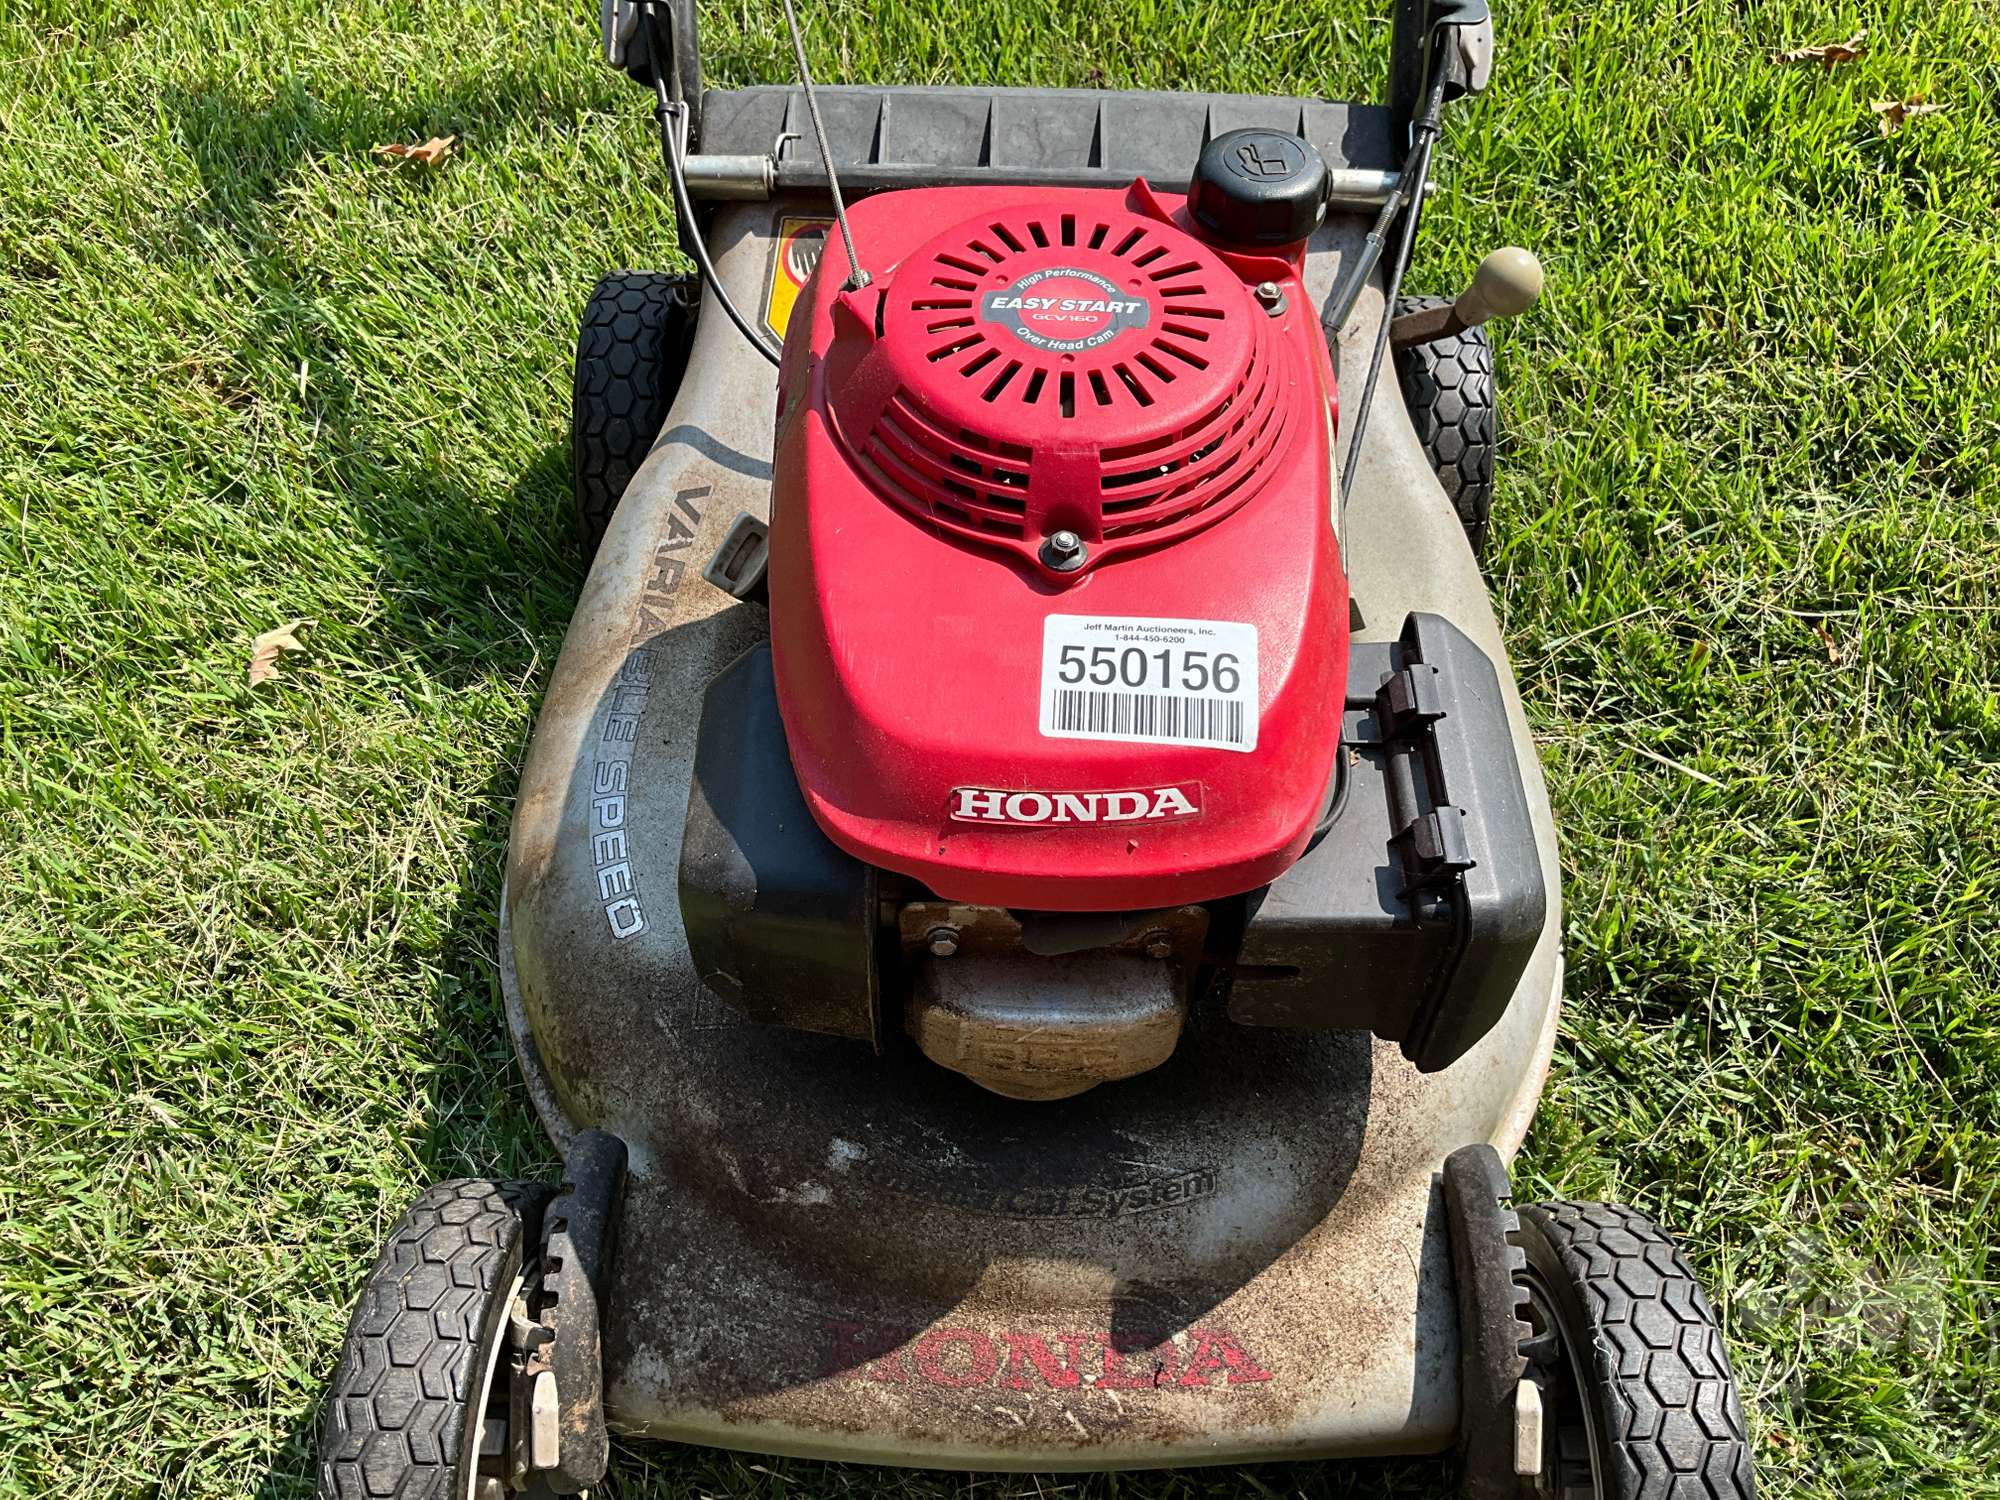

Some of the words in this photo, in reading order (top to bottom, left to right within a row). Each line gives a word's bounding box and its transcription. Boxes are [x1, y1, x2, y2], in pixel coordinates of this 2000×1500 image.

[1017, 272, 1043, 290] High
[1045, 268, 1116, 293] Performance
[991, 297, 1056, 310] EASY
[1060, 299, 1141, 313] START
[1016, 327, 1045, 345] Over
[1048, 340, 1083, 350] Head
[1087, 330, 1114, 346] Cam
[1084, 623, 1102, 631] Jeff
[1104, 624, 1134, 632] Martin
[1136, 625, 1197, 636] Auctioneers,
[1199, 628, 1216, 636] Inc.
[1115, 635, 1185, 644] 1-844-450-6200
[1058, 645, 1240, 693] 550156
[955, 788, 1198, 822] HONDA
[592, 760, 650, 941] SPEED
[1081, 1170, 1215, 1217] System
